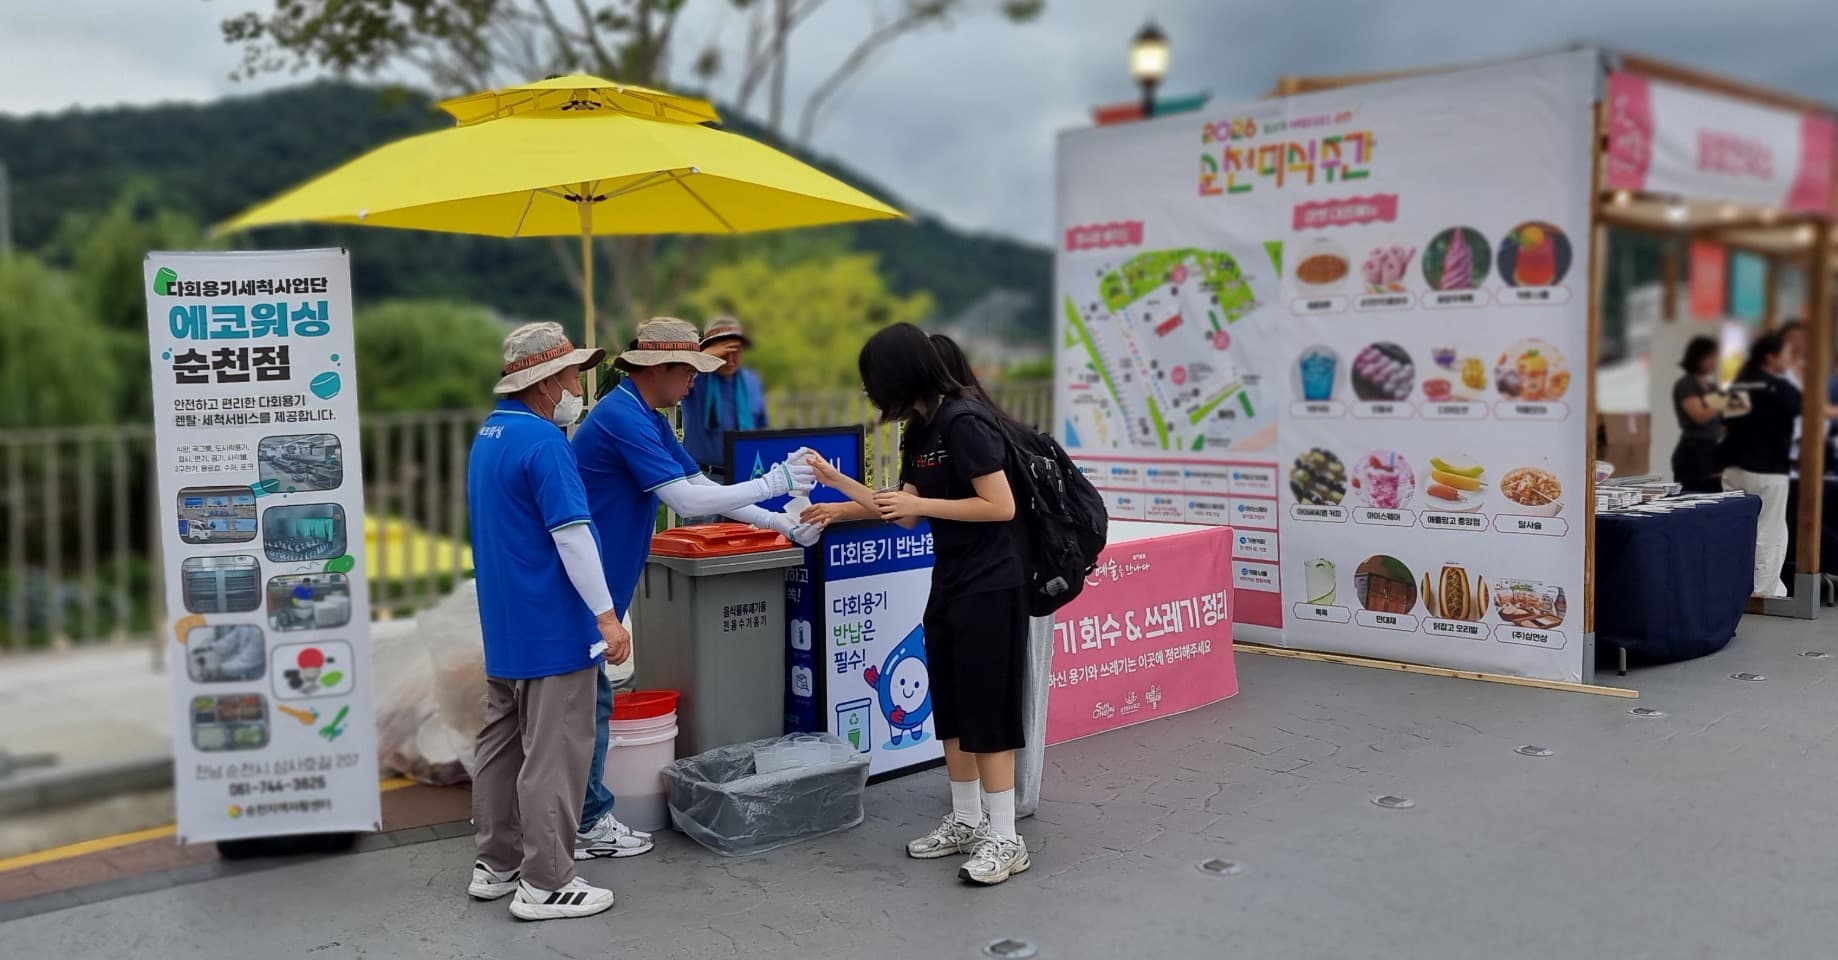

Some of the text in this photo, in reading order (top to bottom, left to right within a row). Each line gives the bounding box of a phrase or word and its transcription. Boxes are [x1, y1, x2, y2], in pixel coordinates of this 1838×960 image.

[166, 277, 328, 297] 다회용기세척사업단
[169, 301, 330, 340] 에코워싱
[172, 345, 291, 384] 순천점
[174, 394, 306, 411] 안전하고 편리한 다회용기
[274, 408, 337, 423] 제공합니다.
[830, 538, 892, 567] 다회용기
[833, 591, 888, 616] 다회용기
[833, 619, 877, 646] 반납은
[1051, 589, 1228, 656] 기 회수 & 쓰레기 정리
[834, 649, 867, 674] 필수!
[1068, 664, 1098, 686] 용기와
[1099, 657, 1137, 678] 쓰레기는
[1138, 648, 1165, 670] 이곳에
[1165, 639, 1211, 664] 정리해주세요
